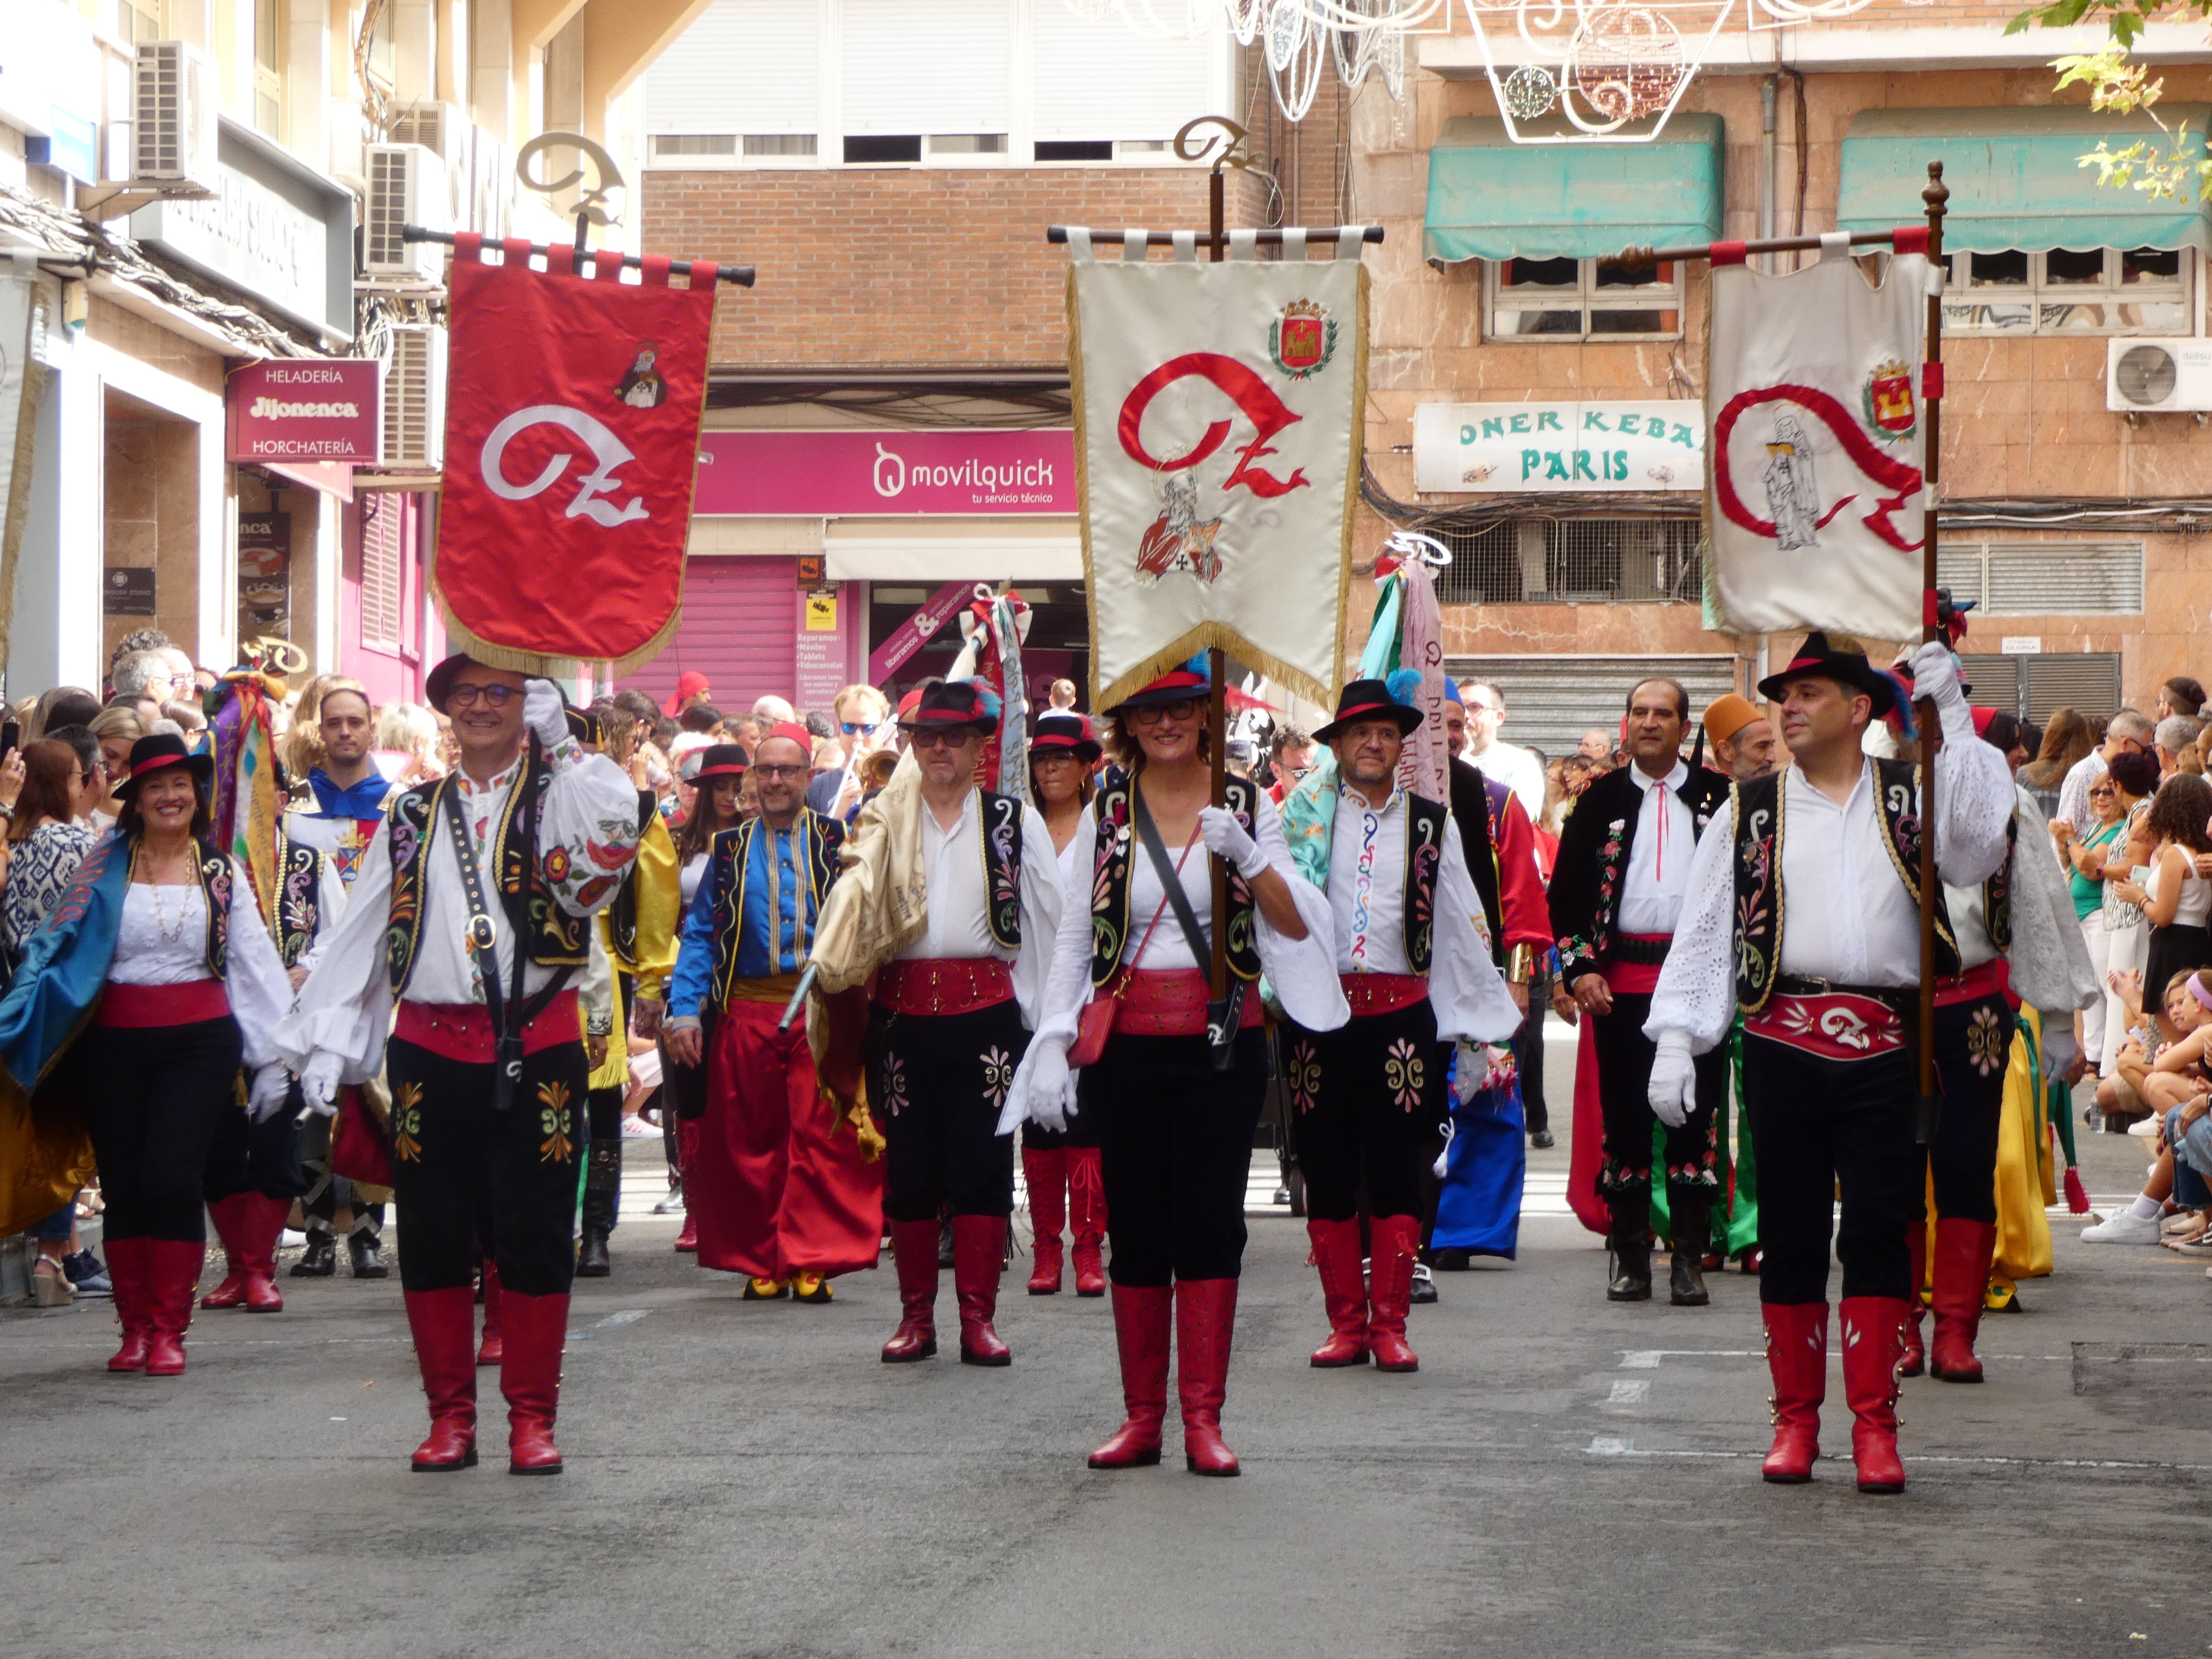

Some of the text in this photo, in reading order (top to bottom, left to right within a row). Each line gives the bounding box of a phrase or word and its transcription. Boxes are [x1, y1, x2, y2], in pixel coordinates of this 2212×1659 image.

[266, 367, 343, 383] HELADERÍA
[250, 396, 359, 420] Jijonenca
[1583, 411, 1705, 452] KEBA
[253, 438, 355, 454] HORCHATERÍA
[912, 458, 1053, 493] movilquick
[1521, 449, 1629, 485] PARIS
[972, 492, 1053, 503] tu servicio técnico
